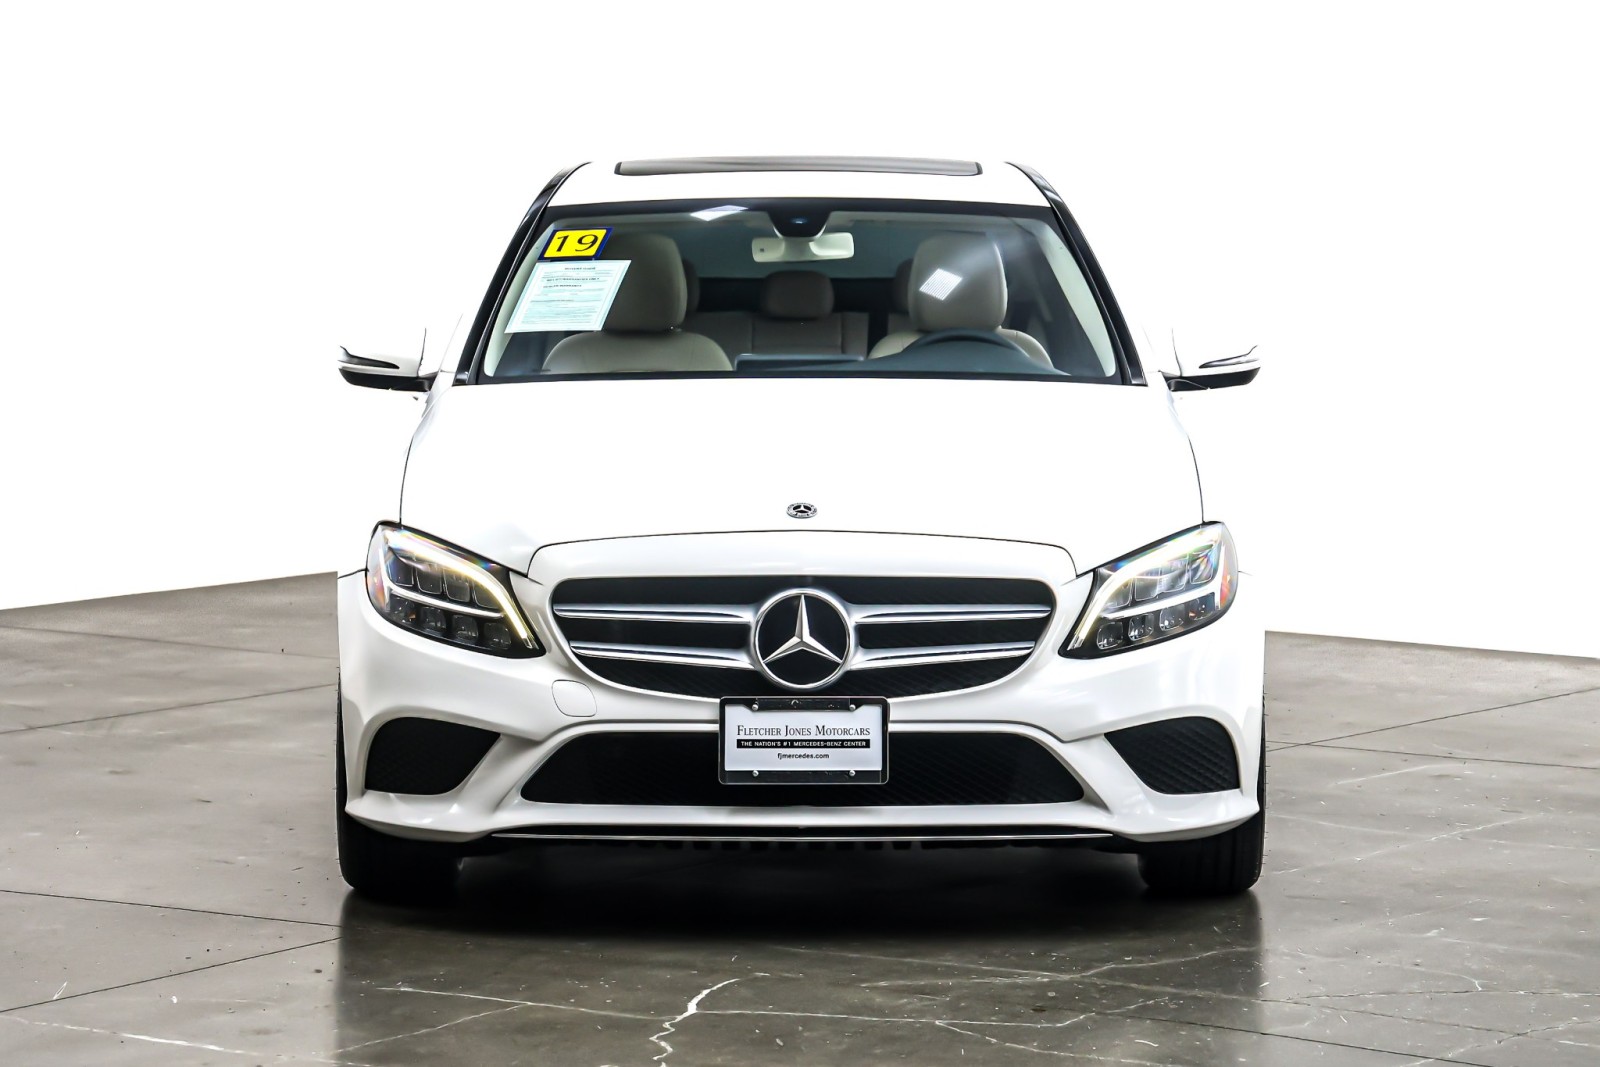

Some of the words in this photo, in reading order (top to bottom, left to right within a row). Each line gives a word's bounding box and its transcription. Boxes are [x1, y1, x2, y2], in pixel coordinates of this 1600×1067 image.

[556, 234, 599, 252] 19
[737, 725, 781, 736] FLETCHER
[784, 725, 812, 737] JONES
[815, 725, 870, 736] MOTORCARS
[777, 752, 829, 760] fjmercedes.com
